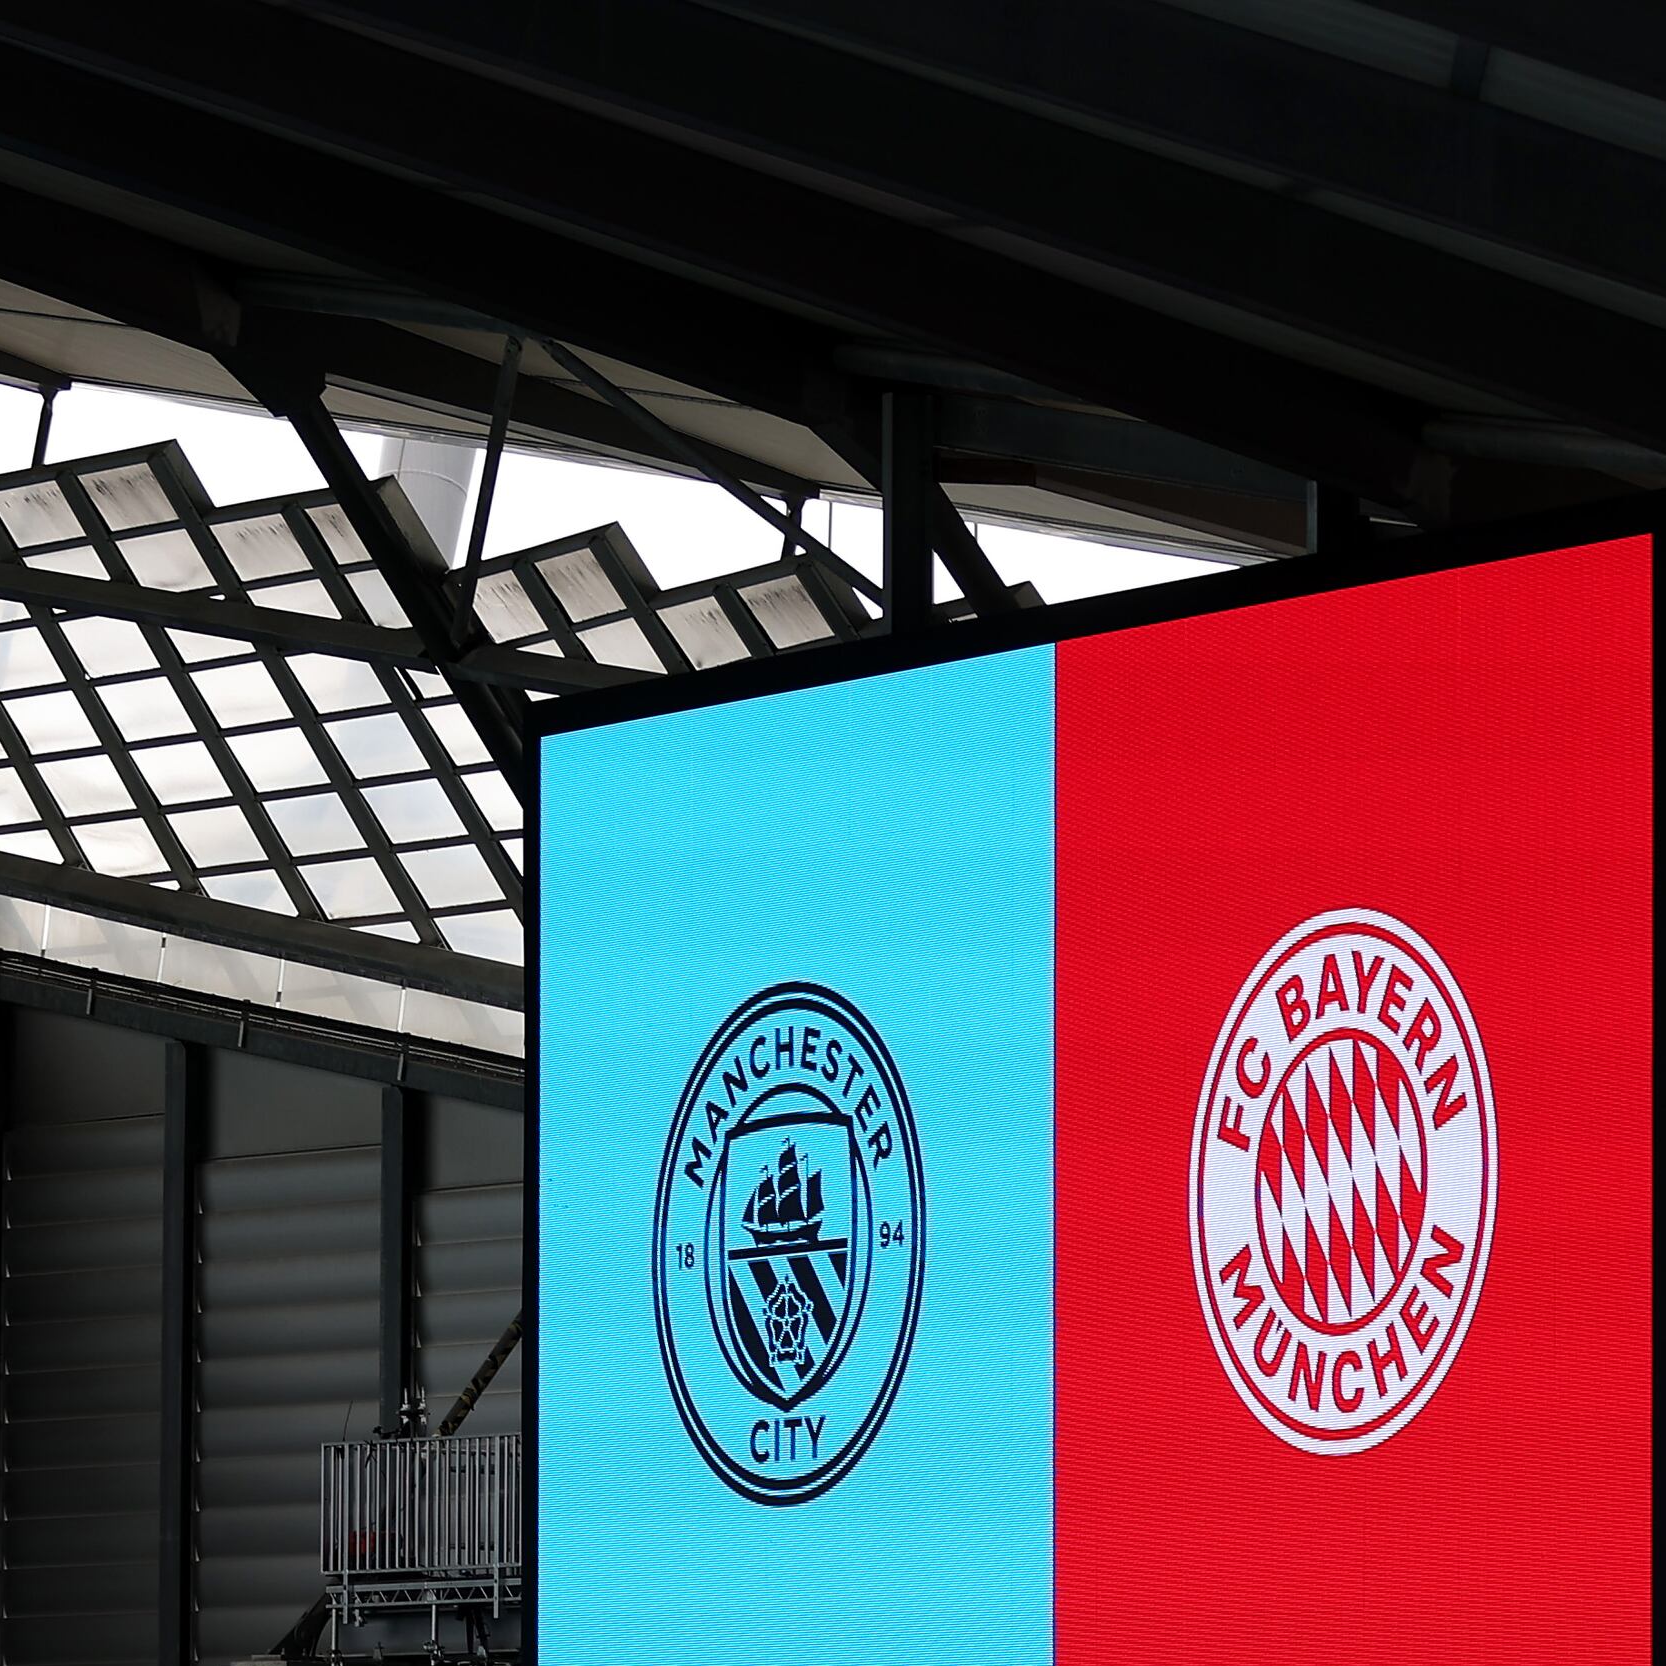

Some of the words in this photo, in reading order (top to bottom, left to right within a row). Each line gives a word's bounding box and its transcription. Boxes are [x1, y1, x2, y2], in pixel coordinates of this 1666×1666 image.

[1217, 1036, 1272, 1152] FC
[1275, 950, 1469, 1131] BAYERN
[683, 1025, 895, 1190] MANCHESTER
[675, 1242, 696, 1271] 18
[878, 1220, 906, 1250] 94
[749, 1415, 827, 1463] CITY
